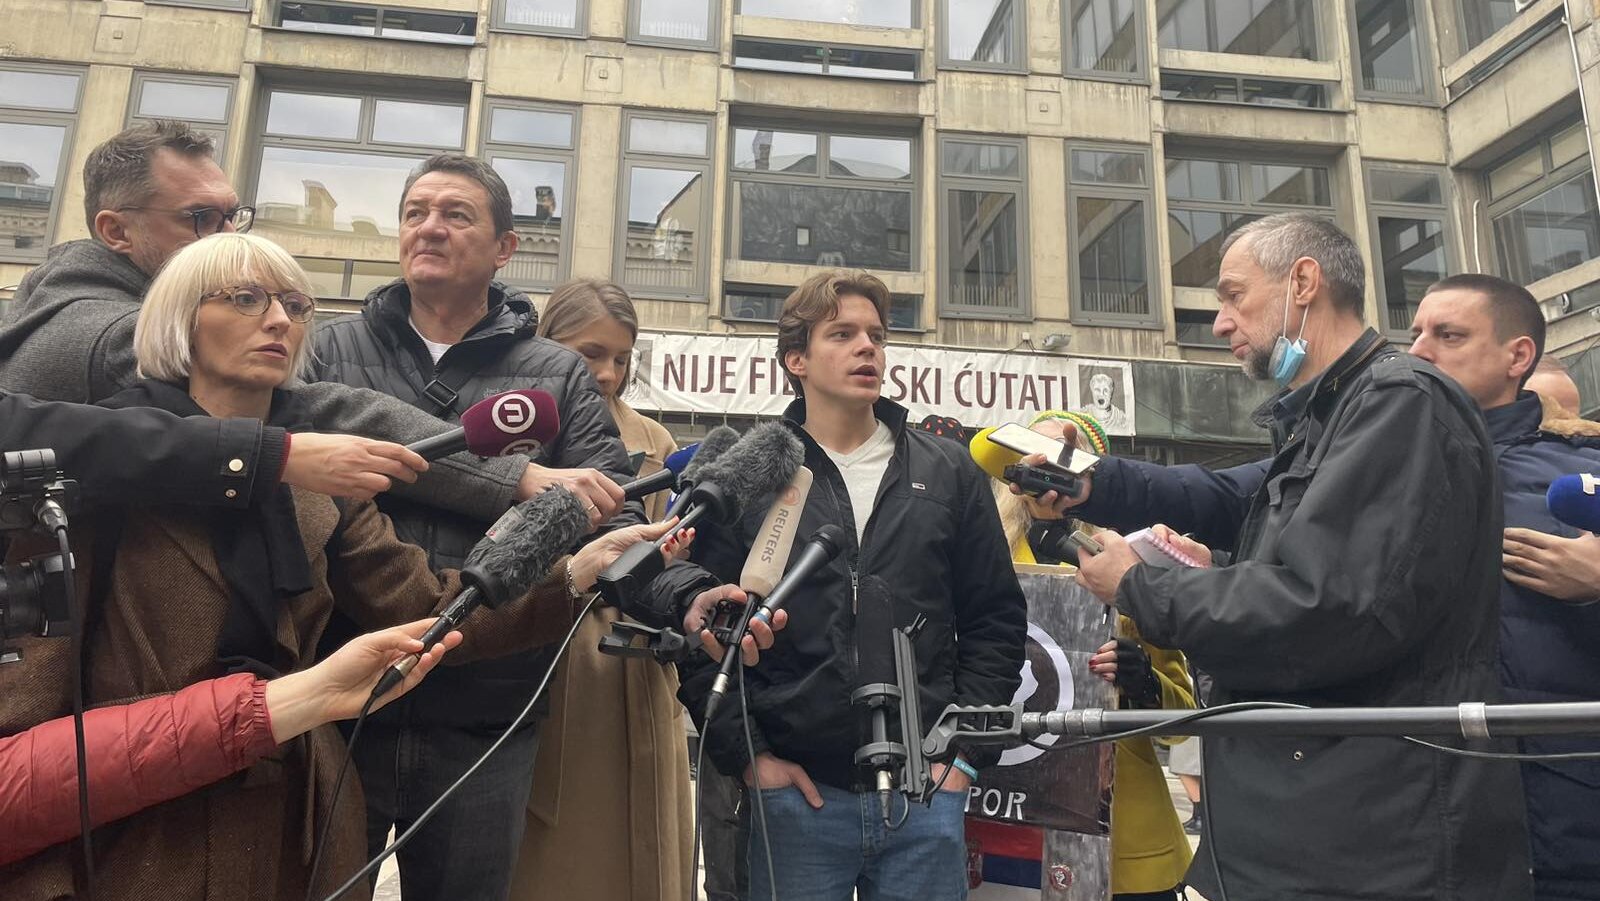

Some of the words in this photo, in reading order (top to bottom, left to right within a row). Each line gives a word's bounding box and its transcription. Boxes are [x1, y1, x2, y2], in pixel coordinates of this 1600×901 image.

[663, 353, 737, 394] NIJE
[750, 357, 942, 405] FILSKI
[954, 363, 1069, 411] ĆUTATI
[761, 508, 789, 563] REUTERS
[964, 786, 1027, 820] POR
